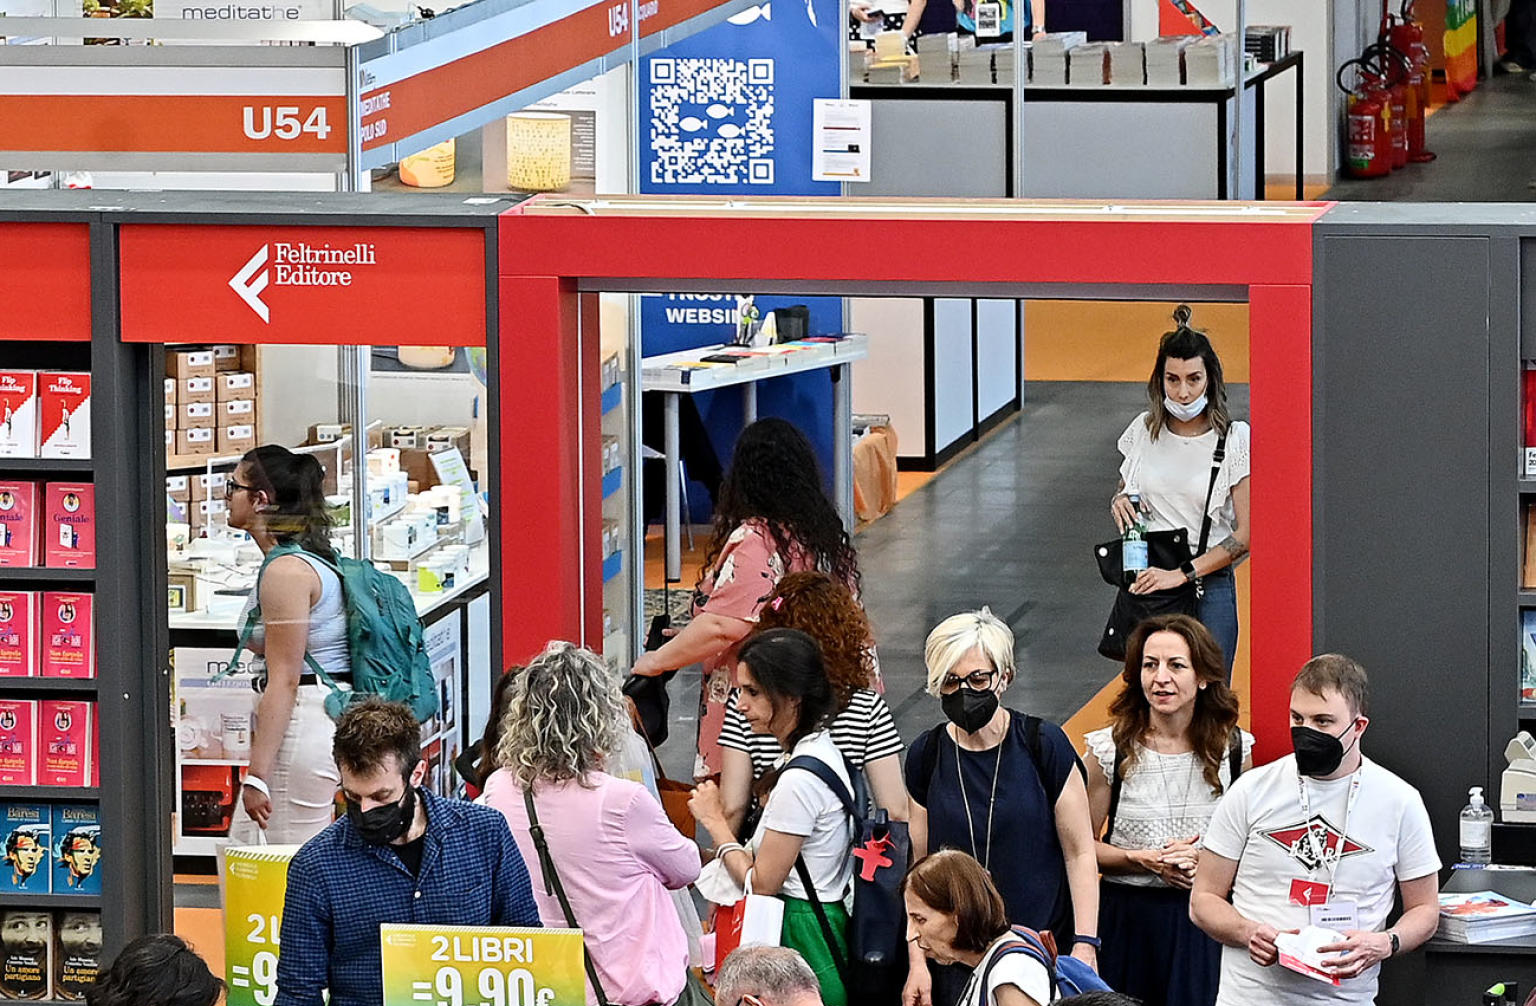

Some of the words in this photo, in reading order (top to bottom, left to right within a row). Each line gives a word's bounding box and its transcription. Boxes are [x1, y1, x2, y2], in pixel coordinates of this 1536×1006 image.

[183, 4, 299, 21] meditathe
[242, 106, 330, 140] U54
[274, 243, 376, 266] Feltrinelli
[274, 264, 352, 287] Editore
[666, 308, 737, 323] WEBSI
[246, 913, 266, 944] 2
[431, 936, 450, 961] 2
[454, 937, 533, 963] LIBRI
[63, 973, 96, 983] partigian
